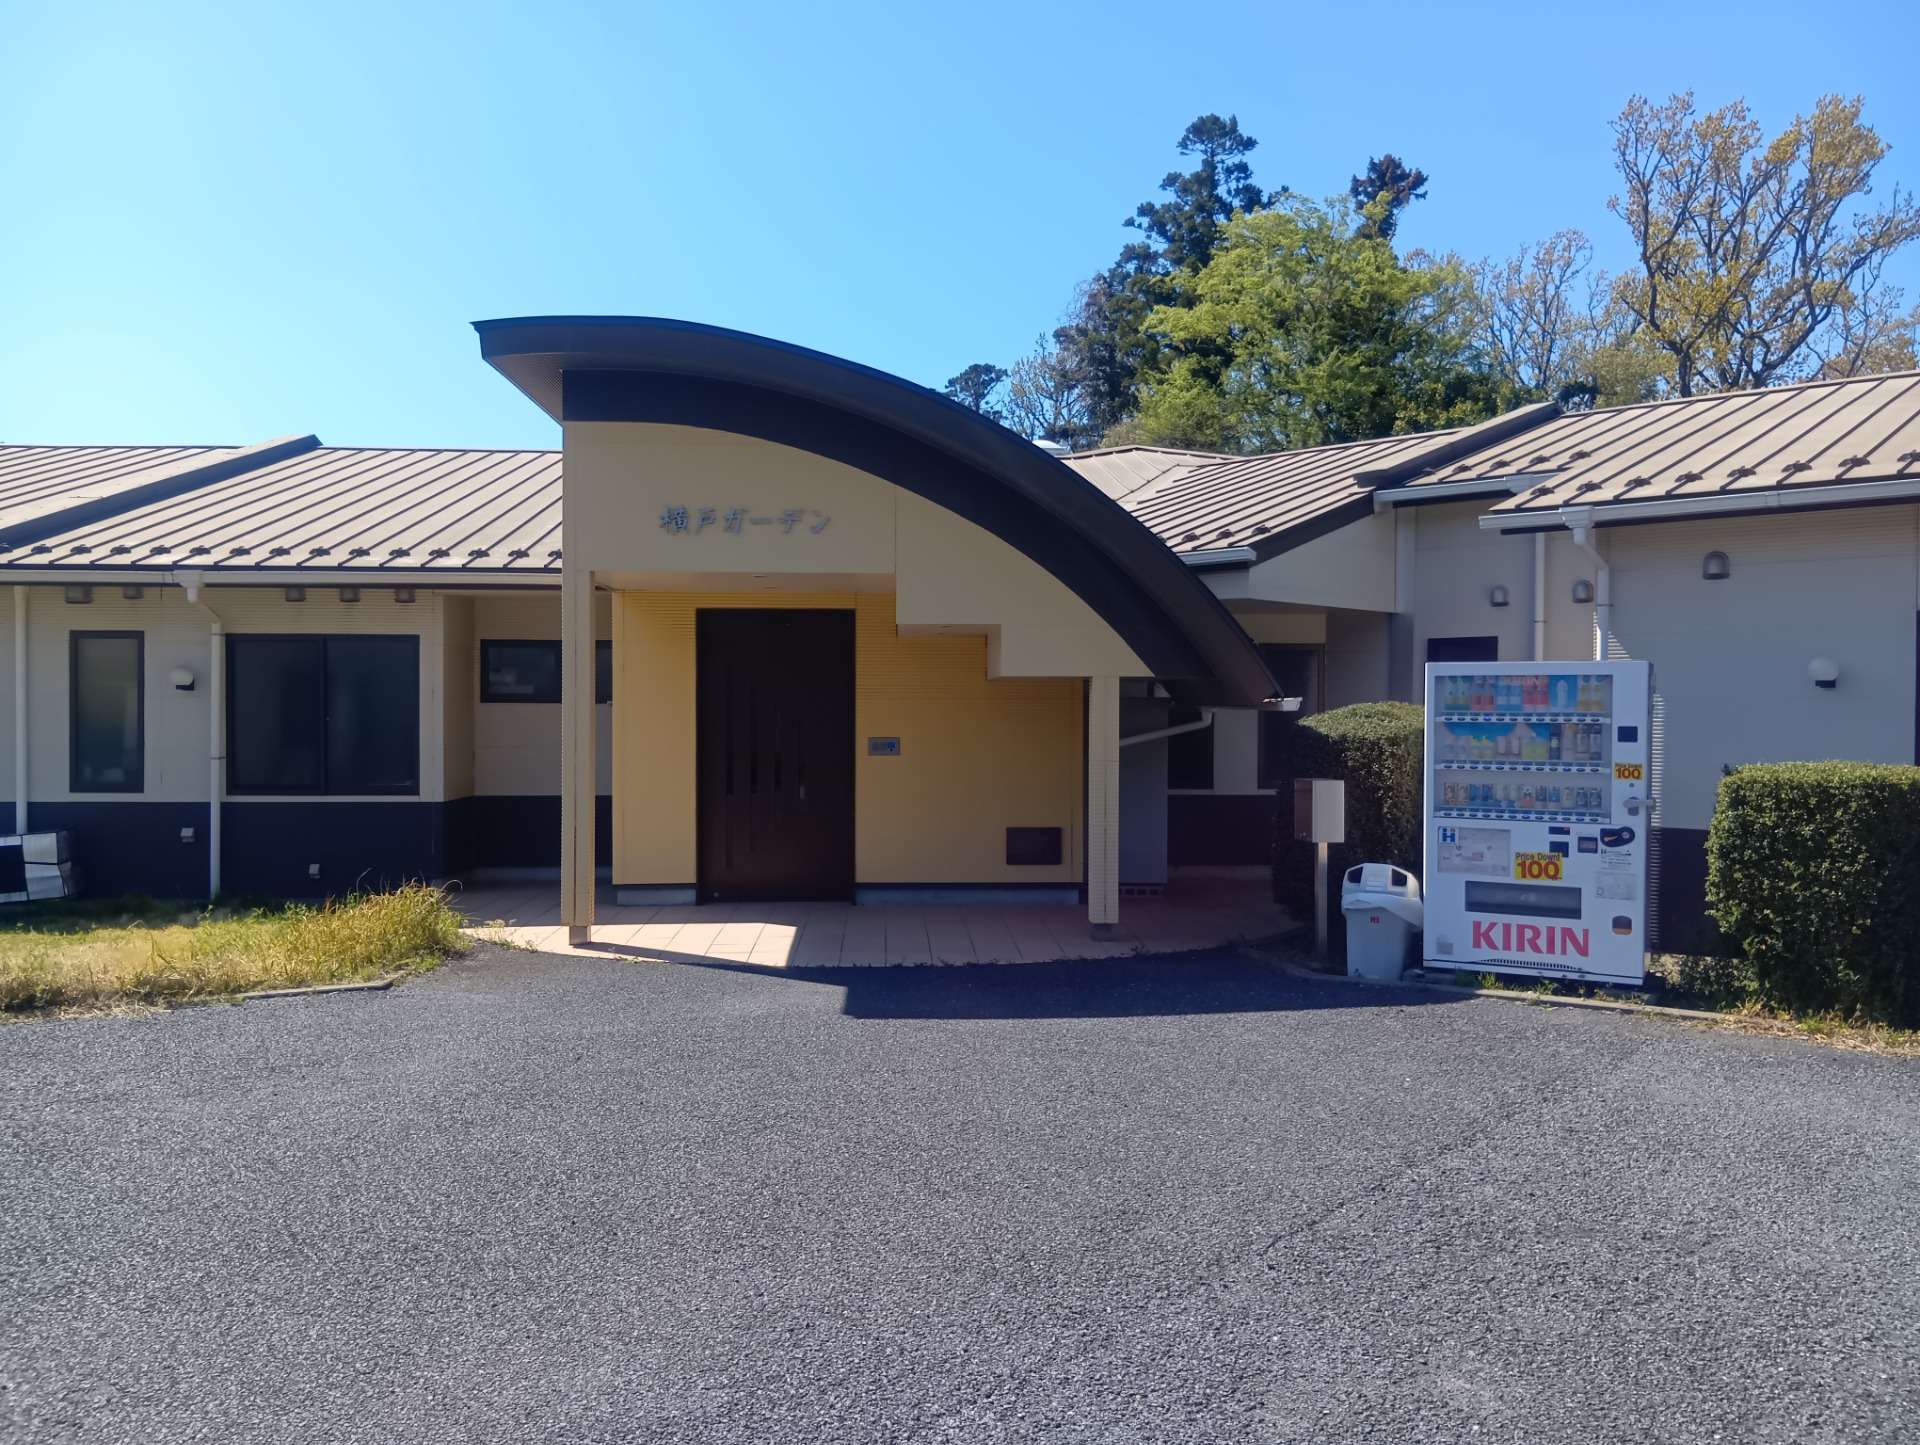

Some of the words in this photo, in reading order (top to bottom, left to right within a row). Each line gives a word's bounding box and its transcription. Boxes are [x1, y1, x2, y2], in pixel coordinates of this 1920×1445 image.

[660, 505, 830, 535] 横戸ガーデン
[1616, 768, 1641, 779] 100
[1516, 852, 1534, 860] Price
[1538, 852, 1560, 861] Down!
[1517, 861, 1560, 880] 100
[1472, 920, 1589, 957] KIRIN
